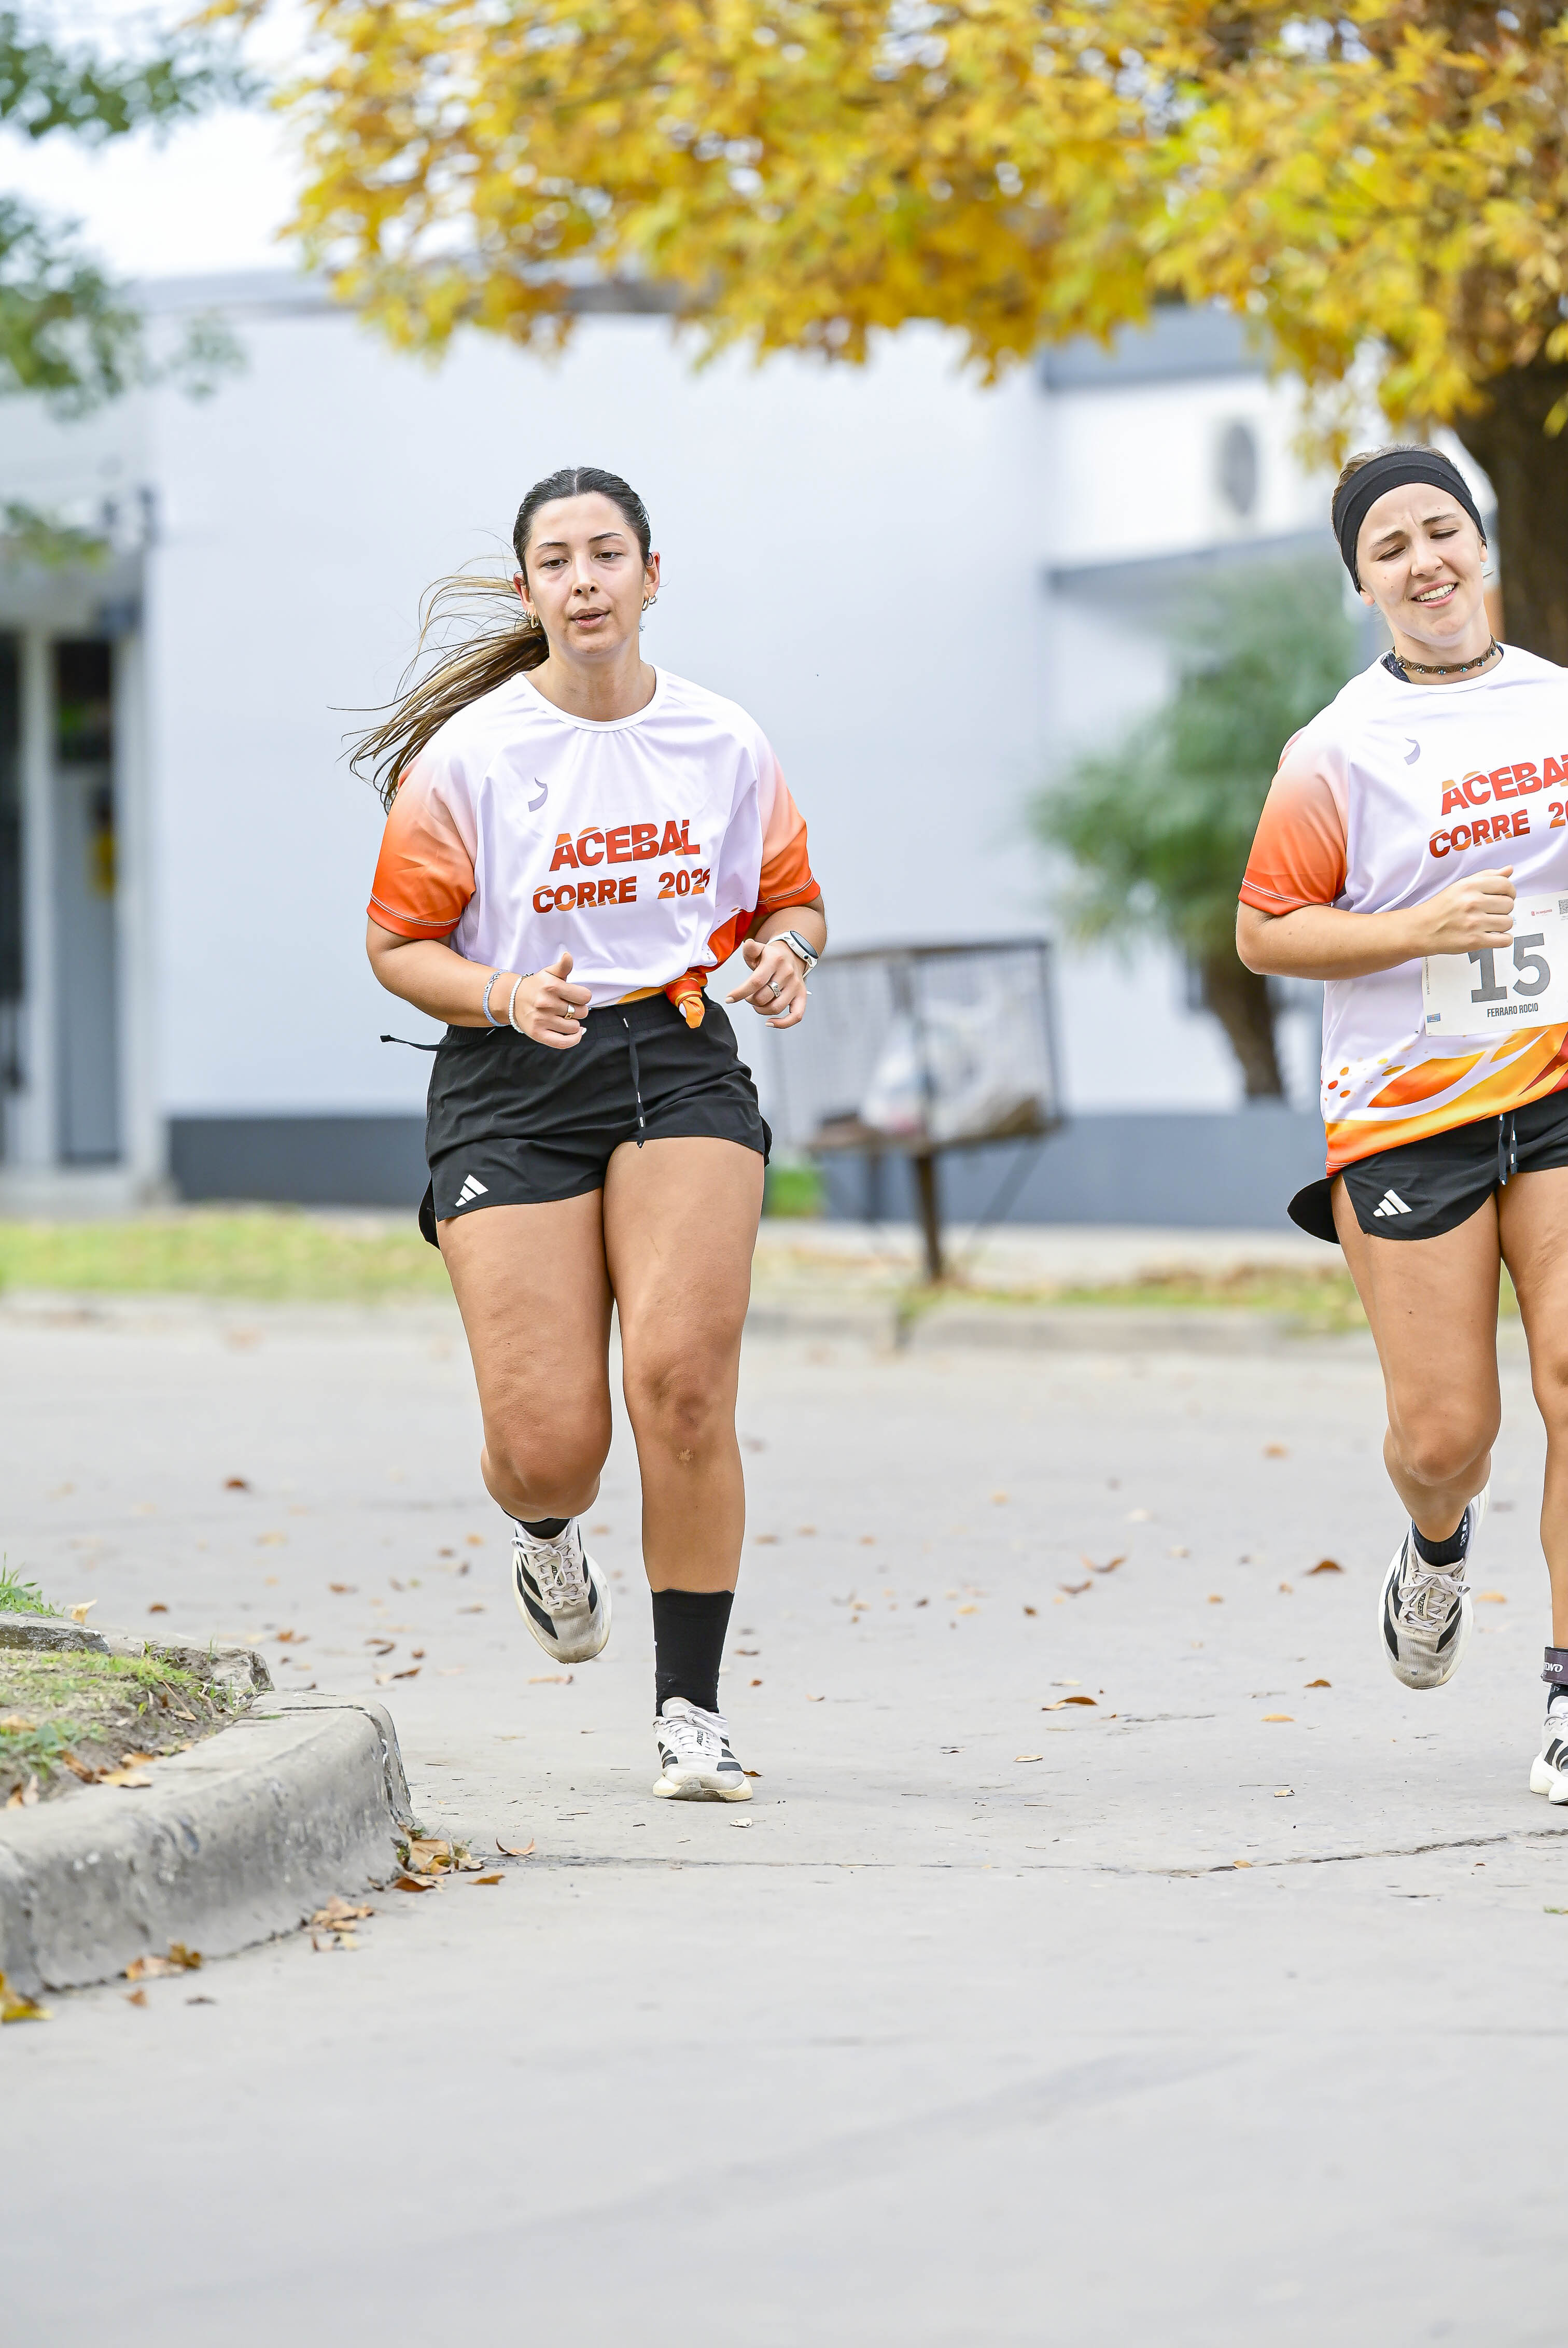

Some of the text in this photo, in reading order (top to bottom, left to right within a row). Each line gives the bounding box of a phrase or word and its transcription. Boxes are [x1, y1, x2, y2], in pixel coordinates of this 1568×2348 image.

[549, 819, 701, 872] ACEBAL
[1429, 800, 1568, 858] CORRE 2
[533, 876, 637, 914] CORRE
[1467, 933, 1551, 1003] 15
[1487, 1003, 1538, 1017] FERRARO ROCIO
